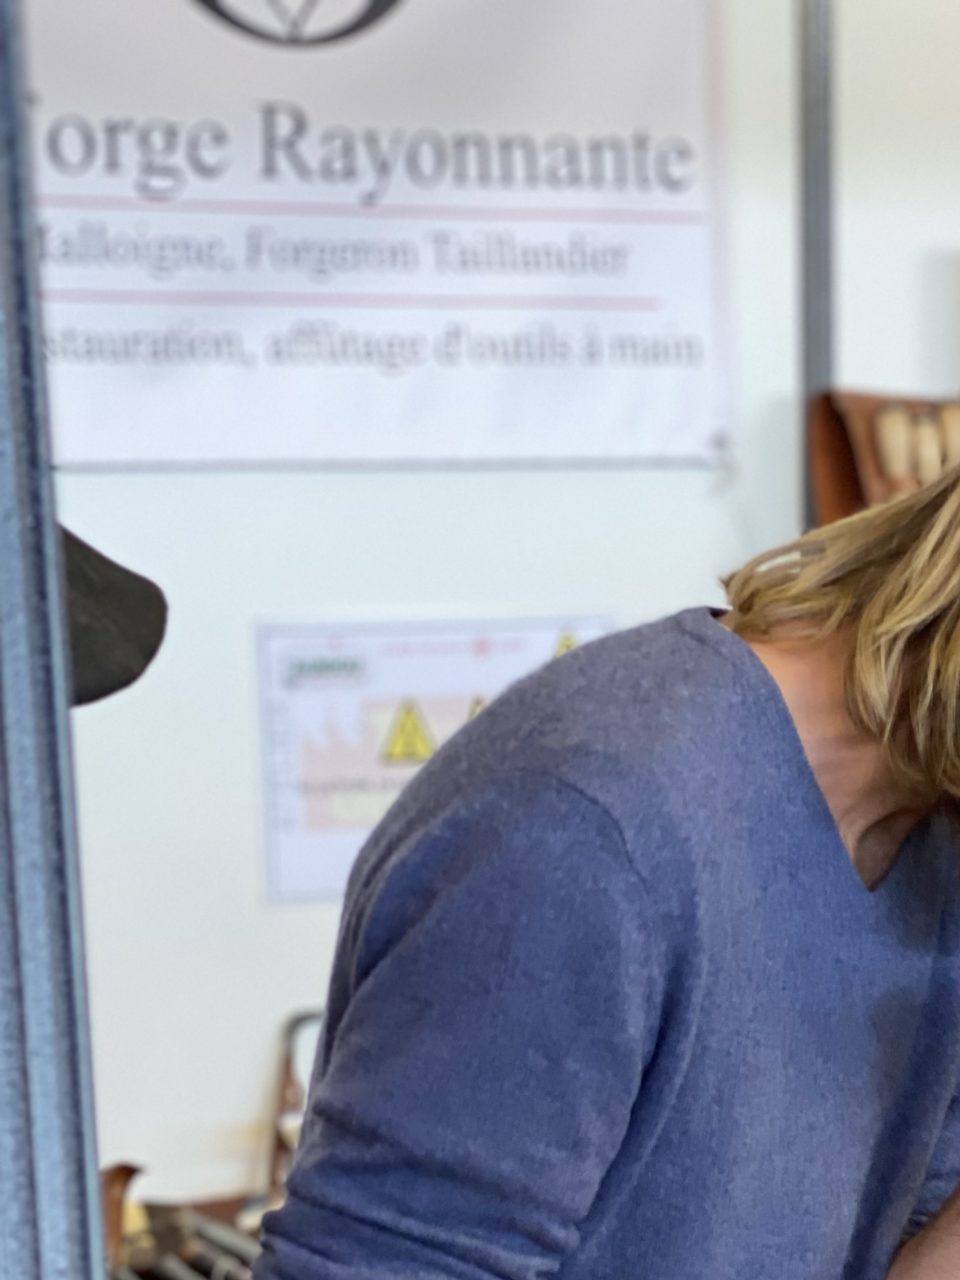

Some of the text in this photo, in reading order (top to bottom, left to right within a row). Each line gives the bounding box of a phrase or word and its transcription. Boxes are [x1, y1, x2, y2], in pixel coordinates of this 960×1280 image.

[46, 101, 695, 206] orge Rayonnante
[46, 321, 258, 367] stauration,
[606, 323, 703, 368] main
